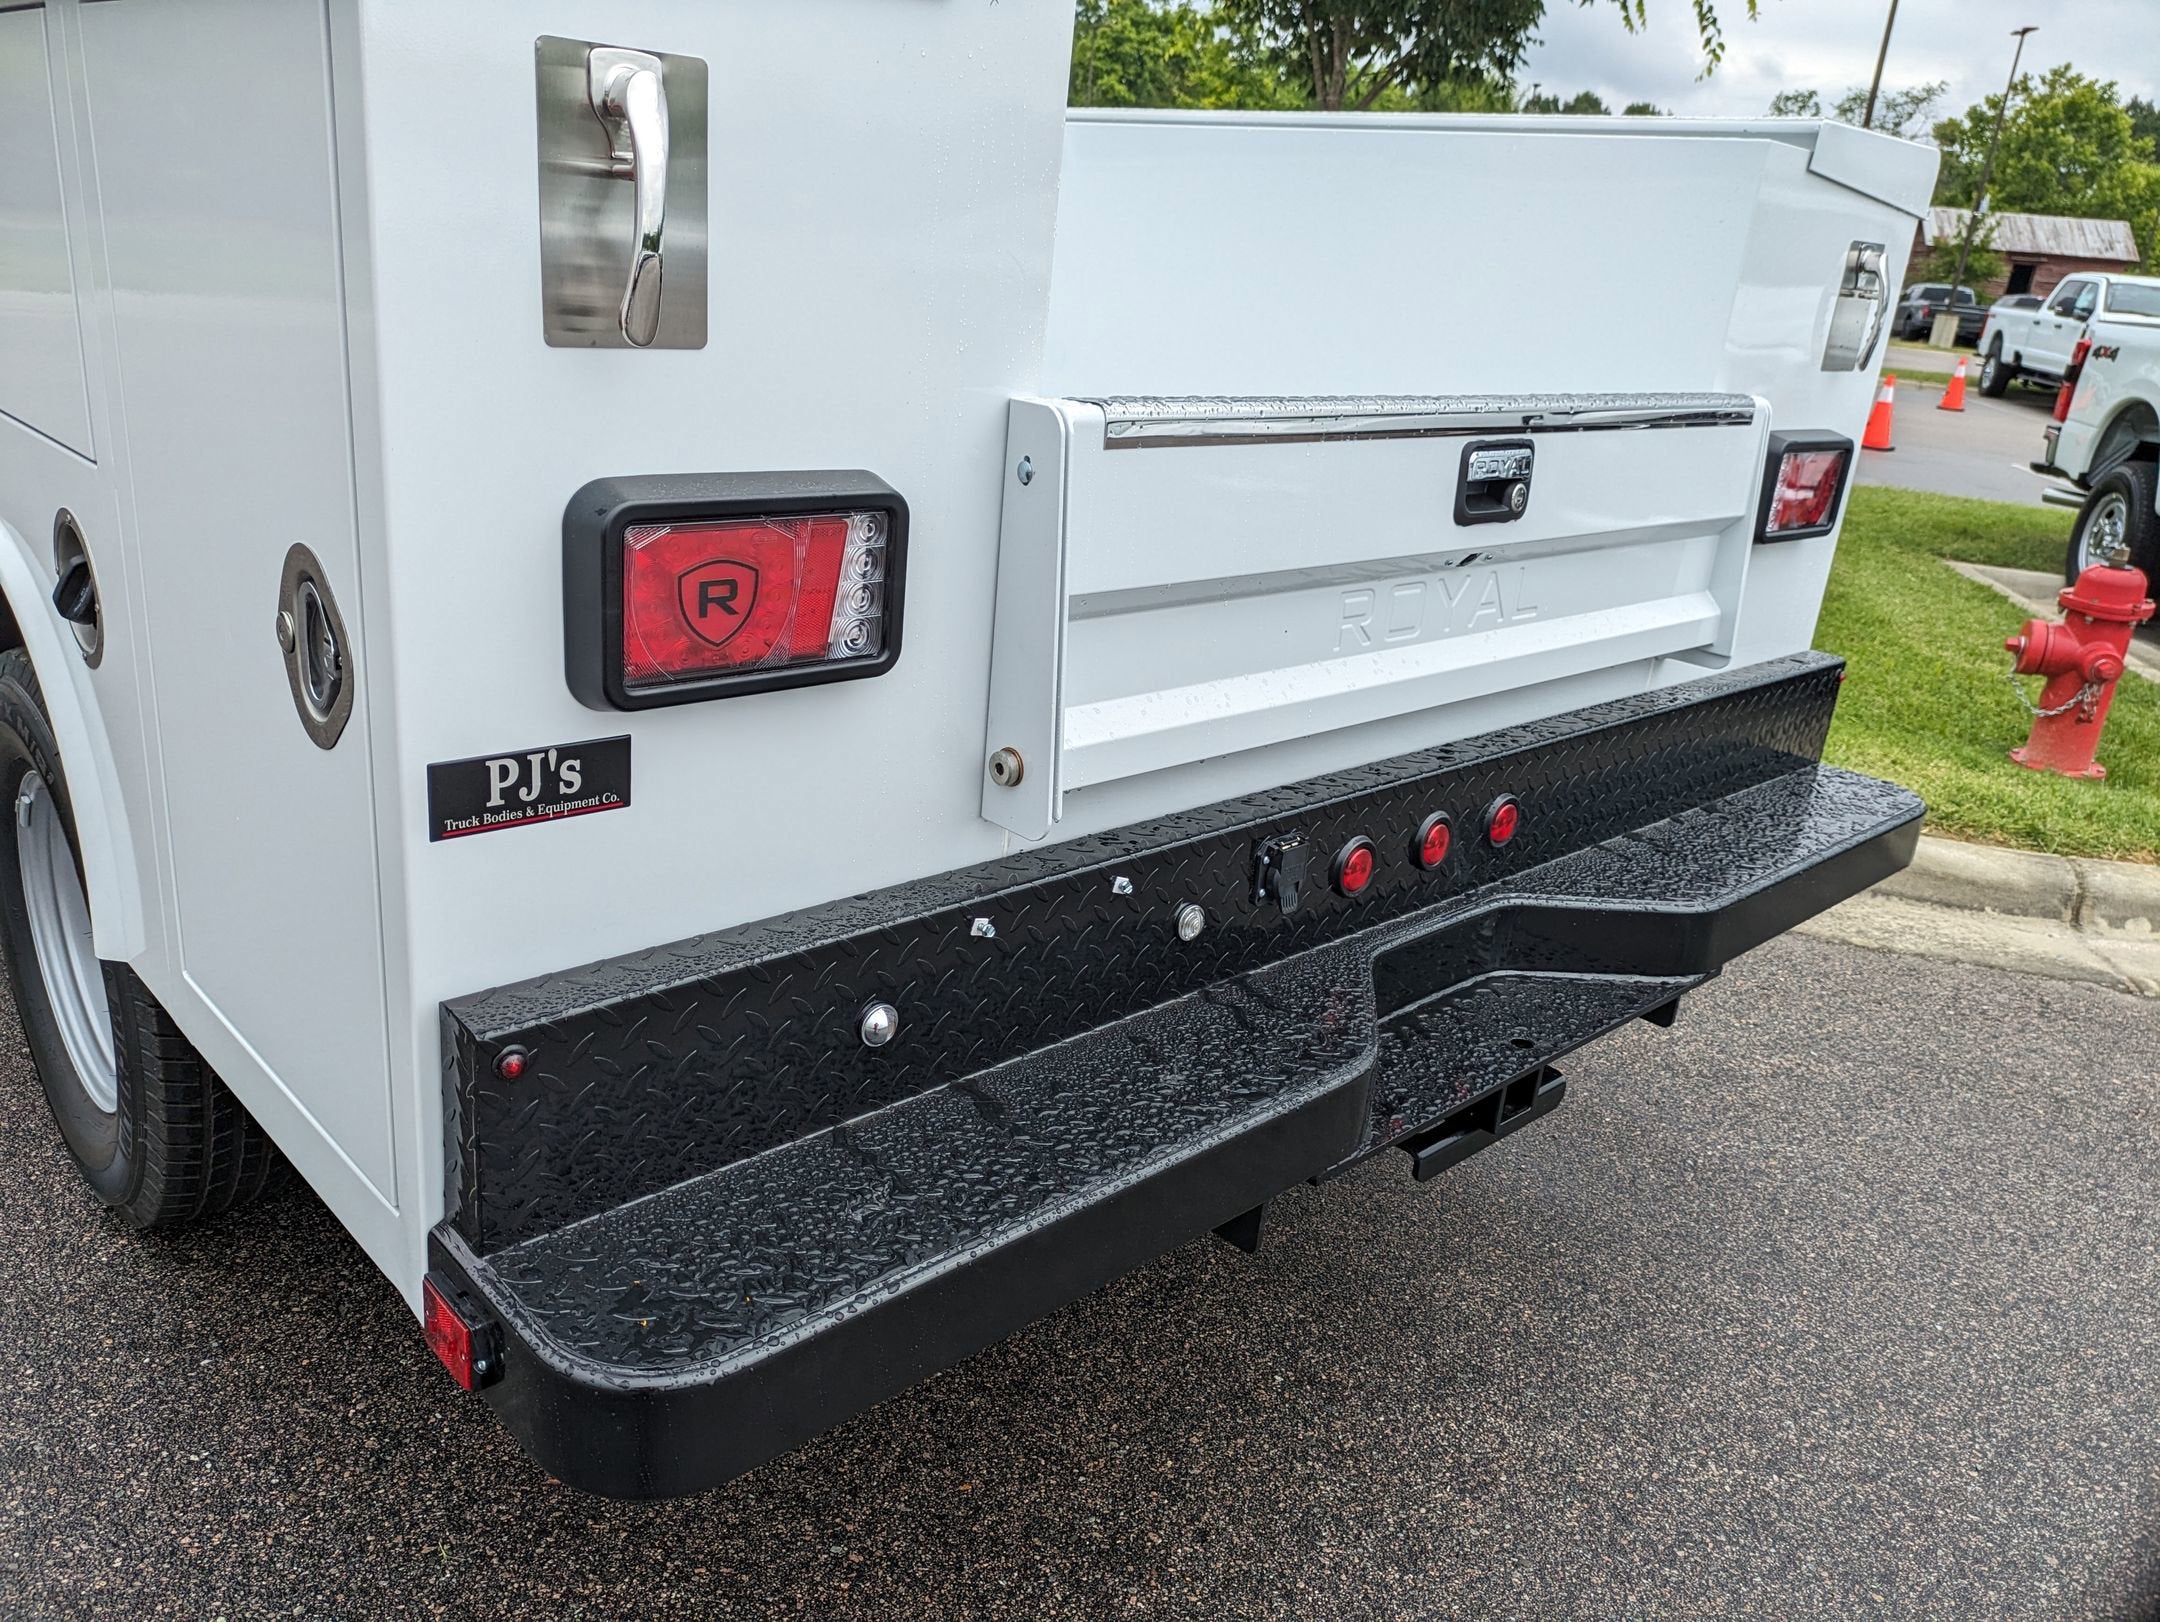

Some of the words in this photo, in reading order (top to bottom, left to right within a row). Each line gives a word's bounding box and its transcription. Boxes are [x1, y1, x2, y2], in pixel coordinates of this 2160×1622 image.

[1474, 456, 1530, 478] ROYAL
[699, 578, 739, 619] R
[1333, 567, 1538, 652] ROYAL
[485, 748, 582, 807] PJ's
[444, 816, 480, 831] Truck
[483, 809, 523, 824] Bodies
[526, 806, 535, 817] &
[537, 795, 600, 817] Equipment
[602, 792, 620, 804] Co.
